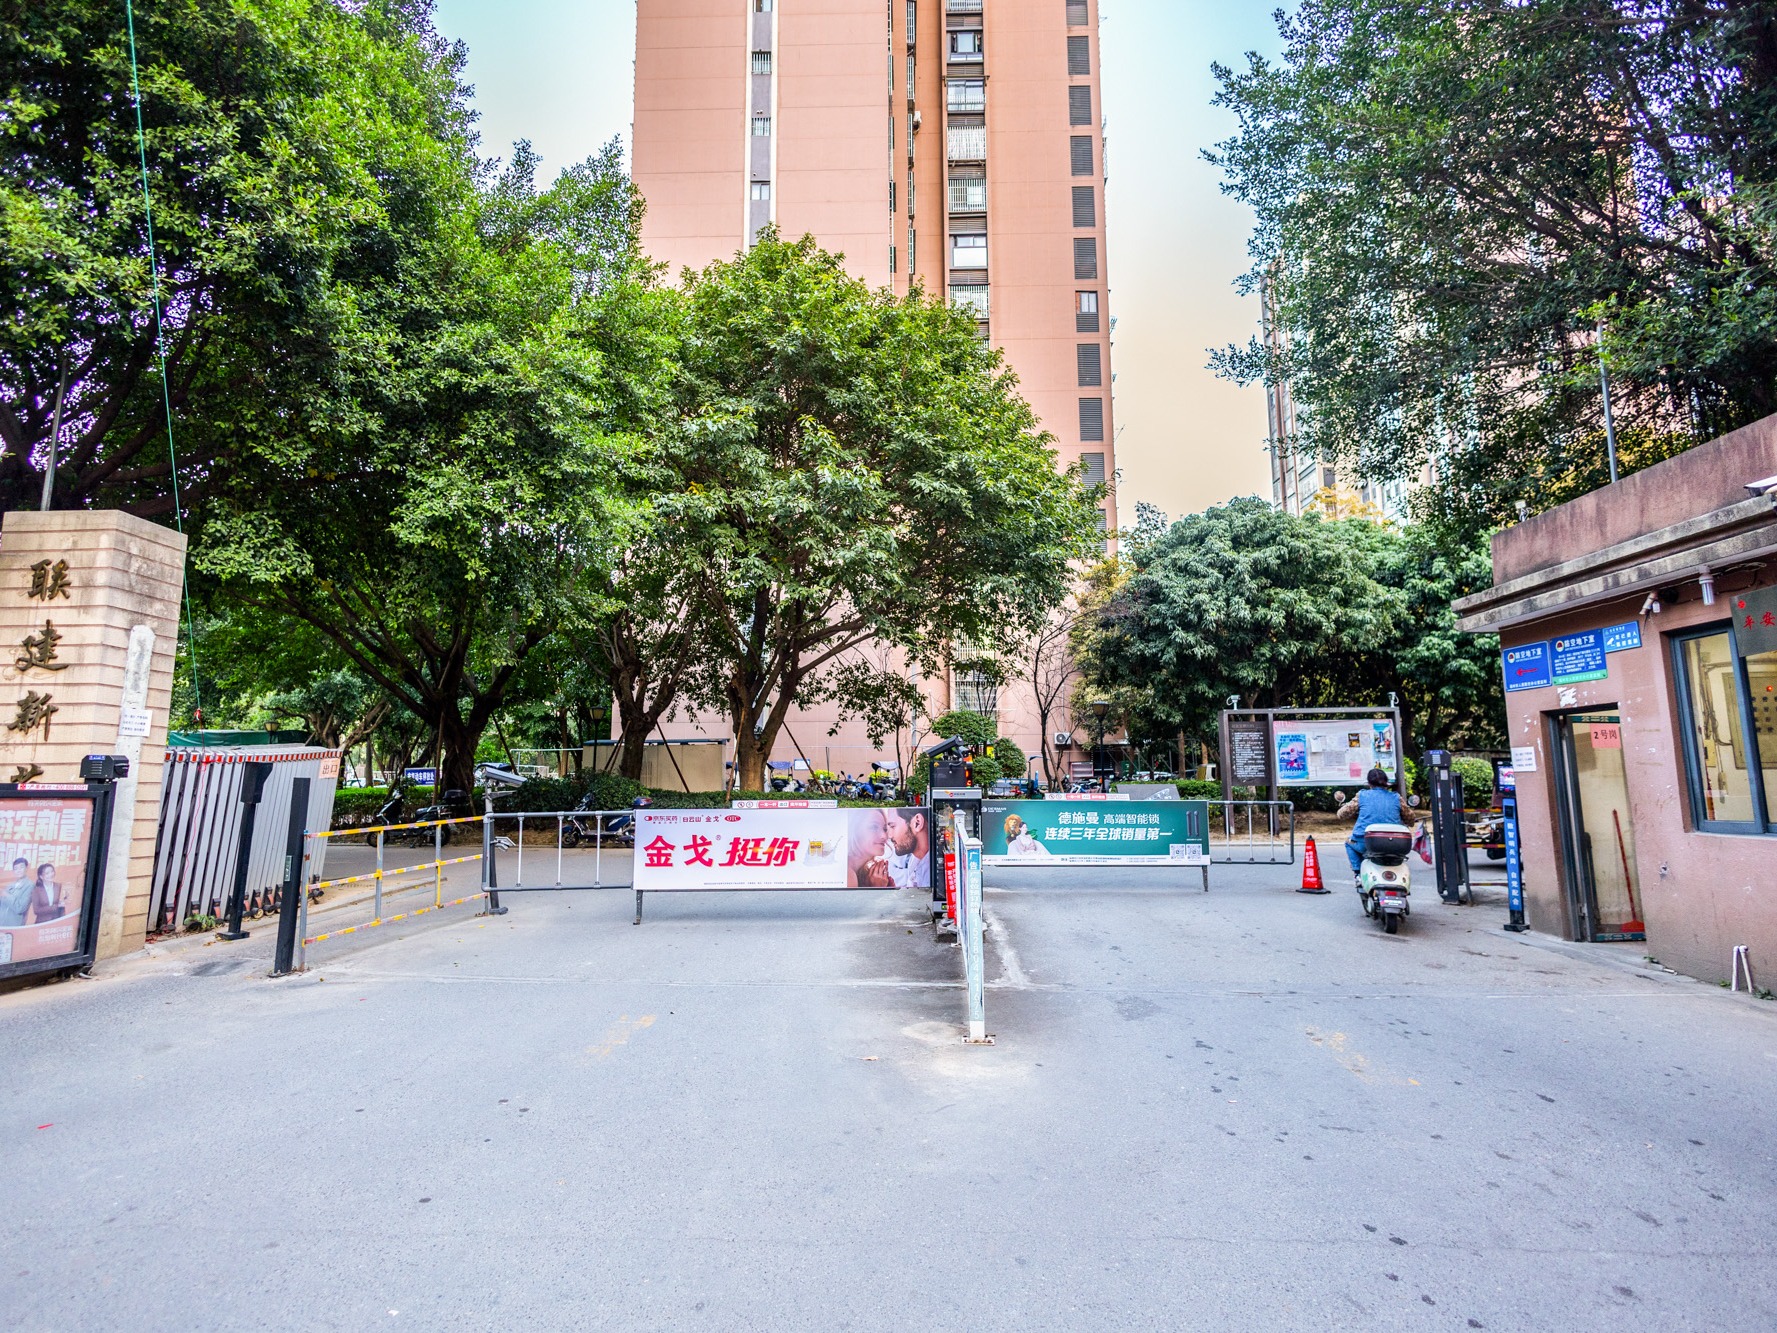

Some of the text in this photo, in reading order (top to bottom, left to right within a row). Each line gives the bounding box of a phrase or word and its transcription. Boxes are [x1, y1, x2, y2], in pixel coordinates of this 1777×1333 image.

[1564, 634, 1595, 648] 防空地下室
[1515, 647, 1542, 660] 防空地下室
[1593, 729, 1617, 740] 2号岗
[322, 764, 338, 775] 出口
[1058, 811, 1160, 825] 德施曼 高端智能锁
[1044, 827, 1172, 841] 连续三年全球销量第一
[719, 836, 800, 867] 挺你
[969, 852, 979, 870] 广告
